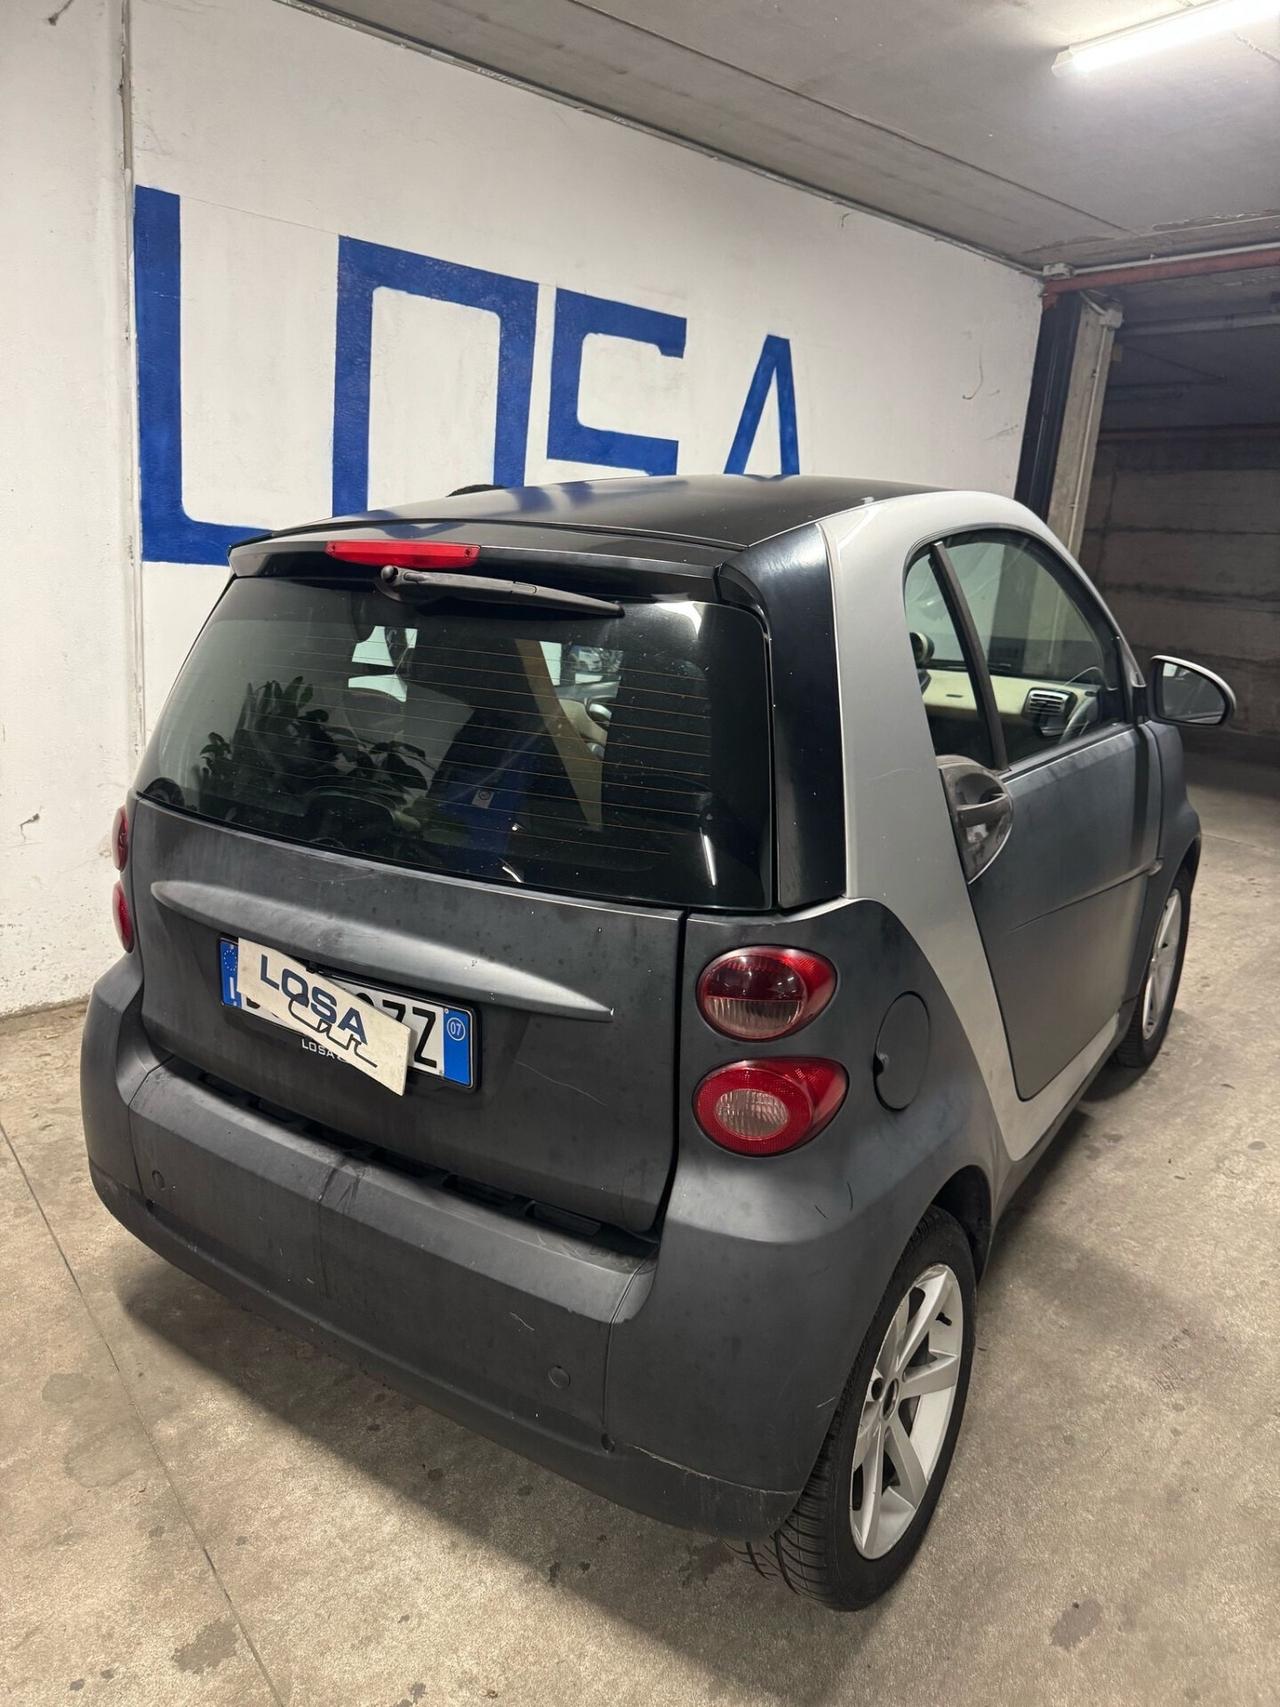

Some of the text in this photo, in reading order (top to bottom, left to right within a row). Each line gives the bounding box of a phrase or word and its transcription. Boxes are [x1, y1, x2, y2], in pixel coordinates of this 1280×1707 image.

[135, 184, 800, 566] LOSA
[260, 953, 368, 1046] LOSA
[301, 1038, 335, 1060] LOSA
[450, 1021, 462, 1036] 07
